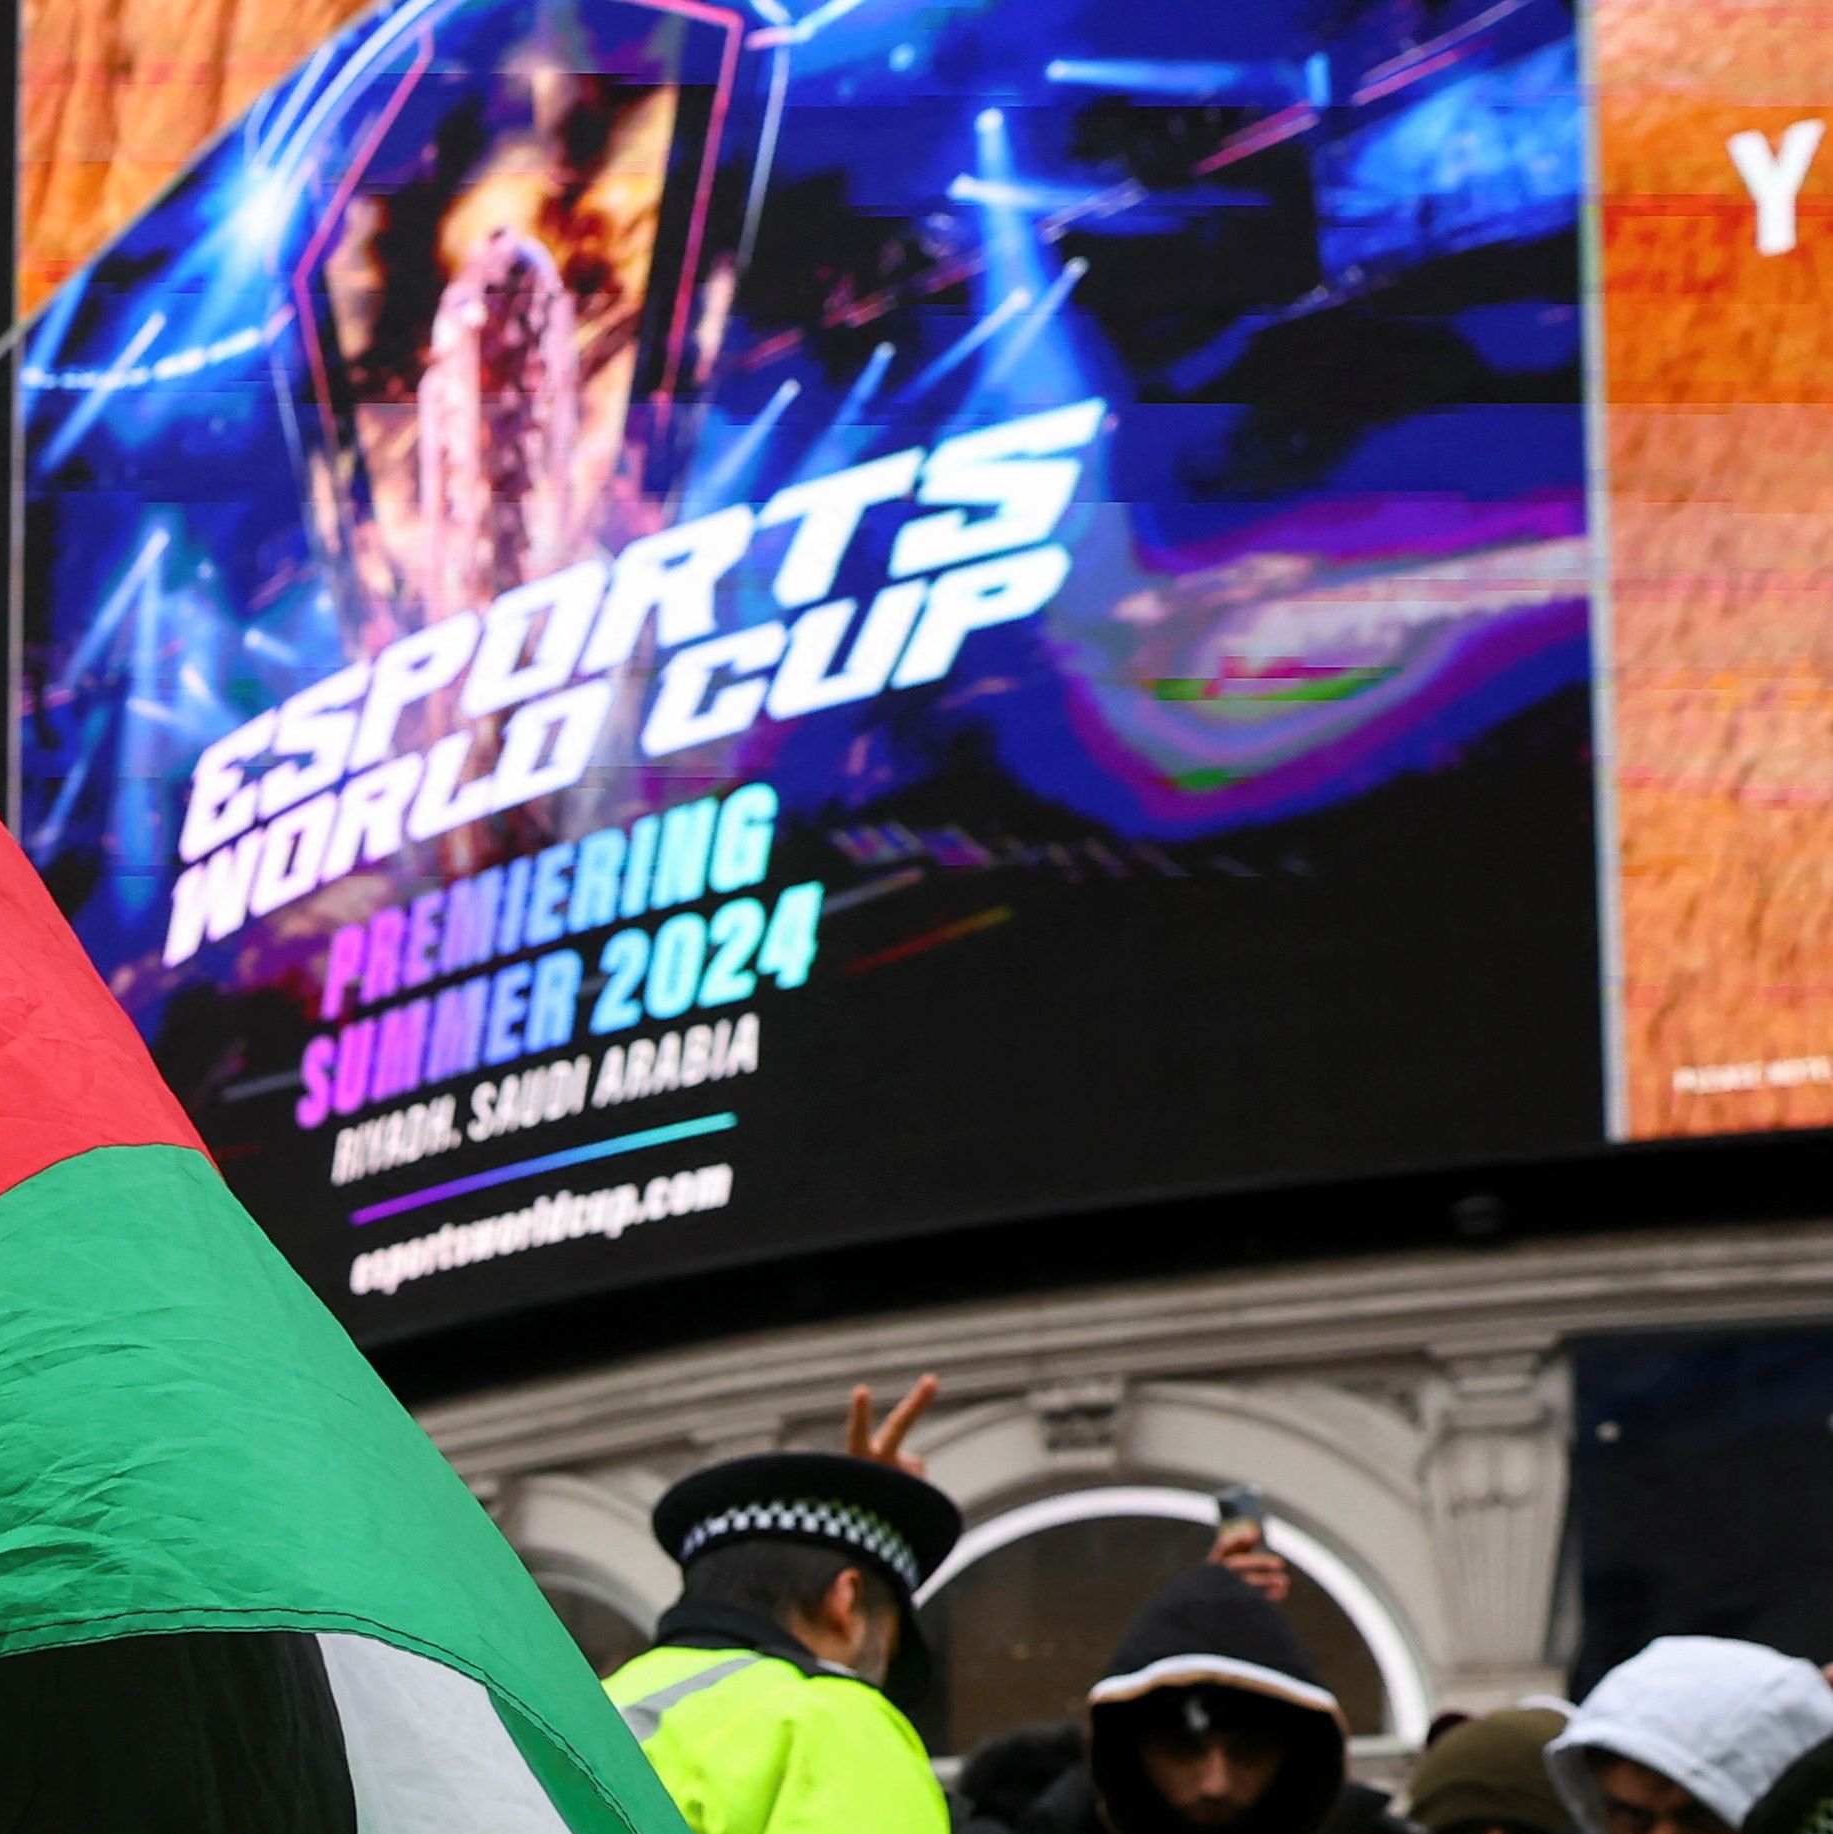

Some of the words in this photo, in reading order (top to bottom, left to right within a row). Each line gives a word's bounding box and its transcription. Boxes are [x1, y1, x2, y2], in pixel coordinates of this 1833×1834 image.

[179, 398, 1107, 864] ESPORTS
[163, 681, 617, 967] WORLD
[641, 543, 1072, 757] CUP
[295, 949, 584, 1129] SUMMER
[589, 880, 825, 1036] 2024
[321, 782, 779, 1022] PREMIERING
[467, 1054, 591, 1142] SAUDI
[591, 1012, 761, 1107] ARABIA
[349, 1163, 733, 1295] esportsworldcup.com
